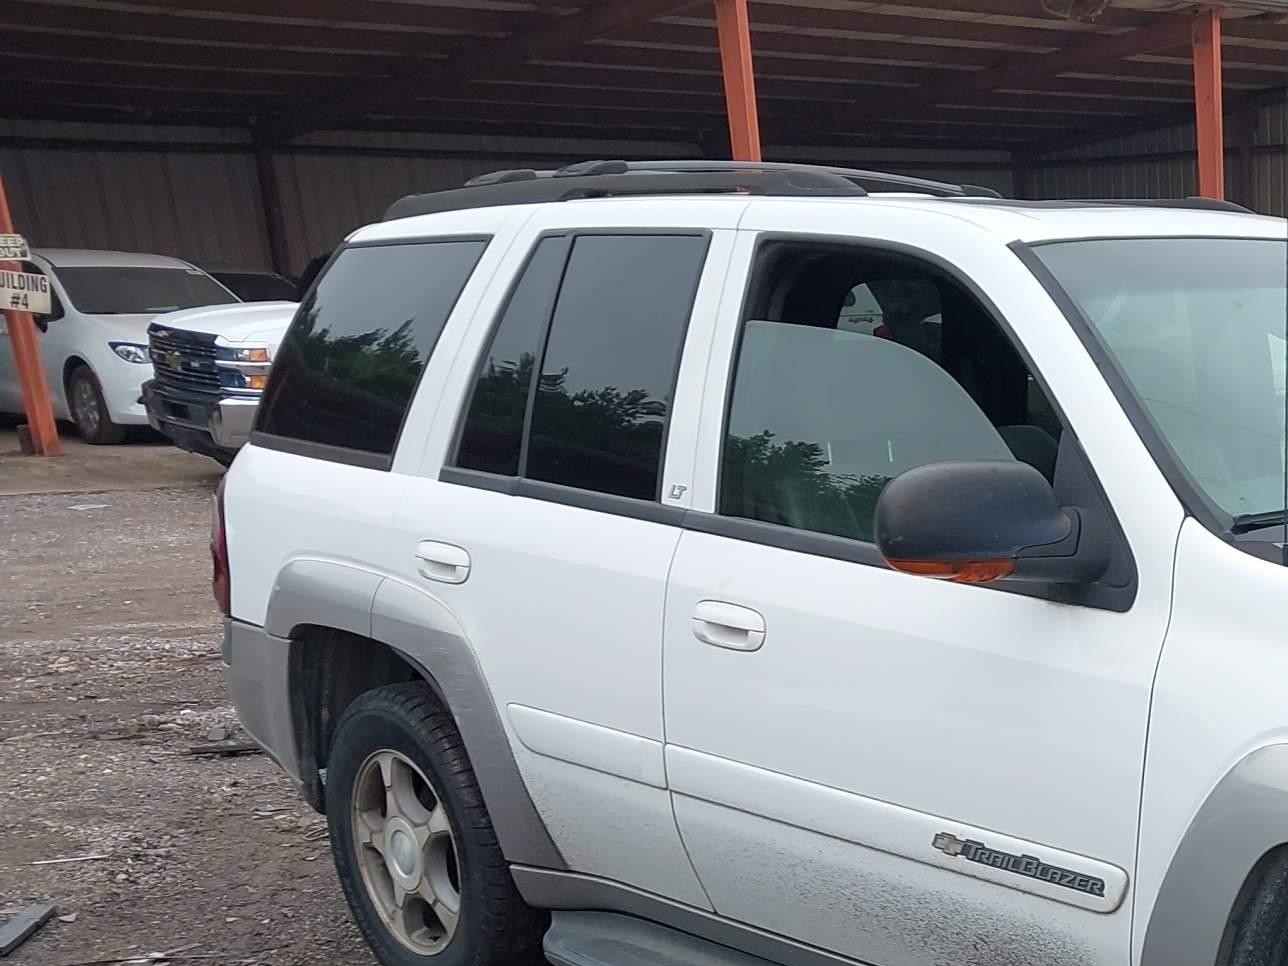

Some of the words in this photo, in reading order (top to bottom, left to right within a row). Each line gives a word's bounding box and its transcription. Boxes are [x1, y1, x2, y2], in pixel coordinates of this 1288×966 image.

[0, 236, 23, 246] EEP
[0, 271, 48, 293] UILDING
[10, 292, 29, 310] #4
[668, 484, 687, 499] LT
